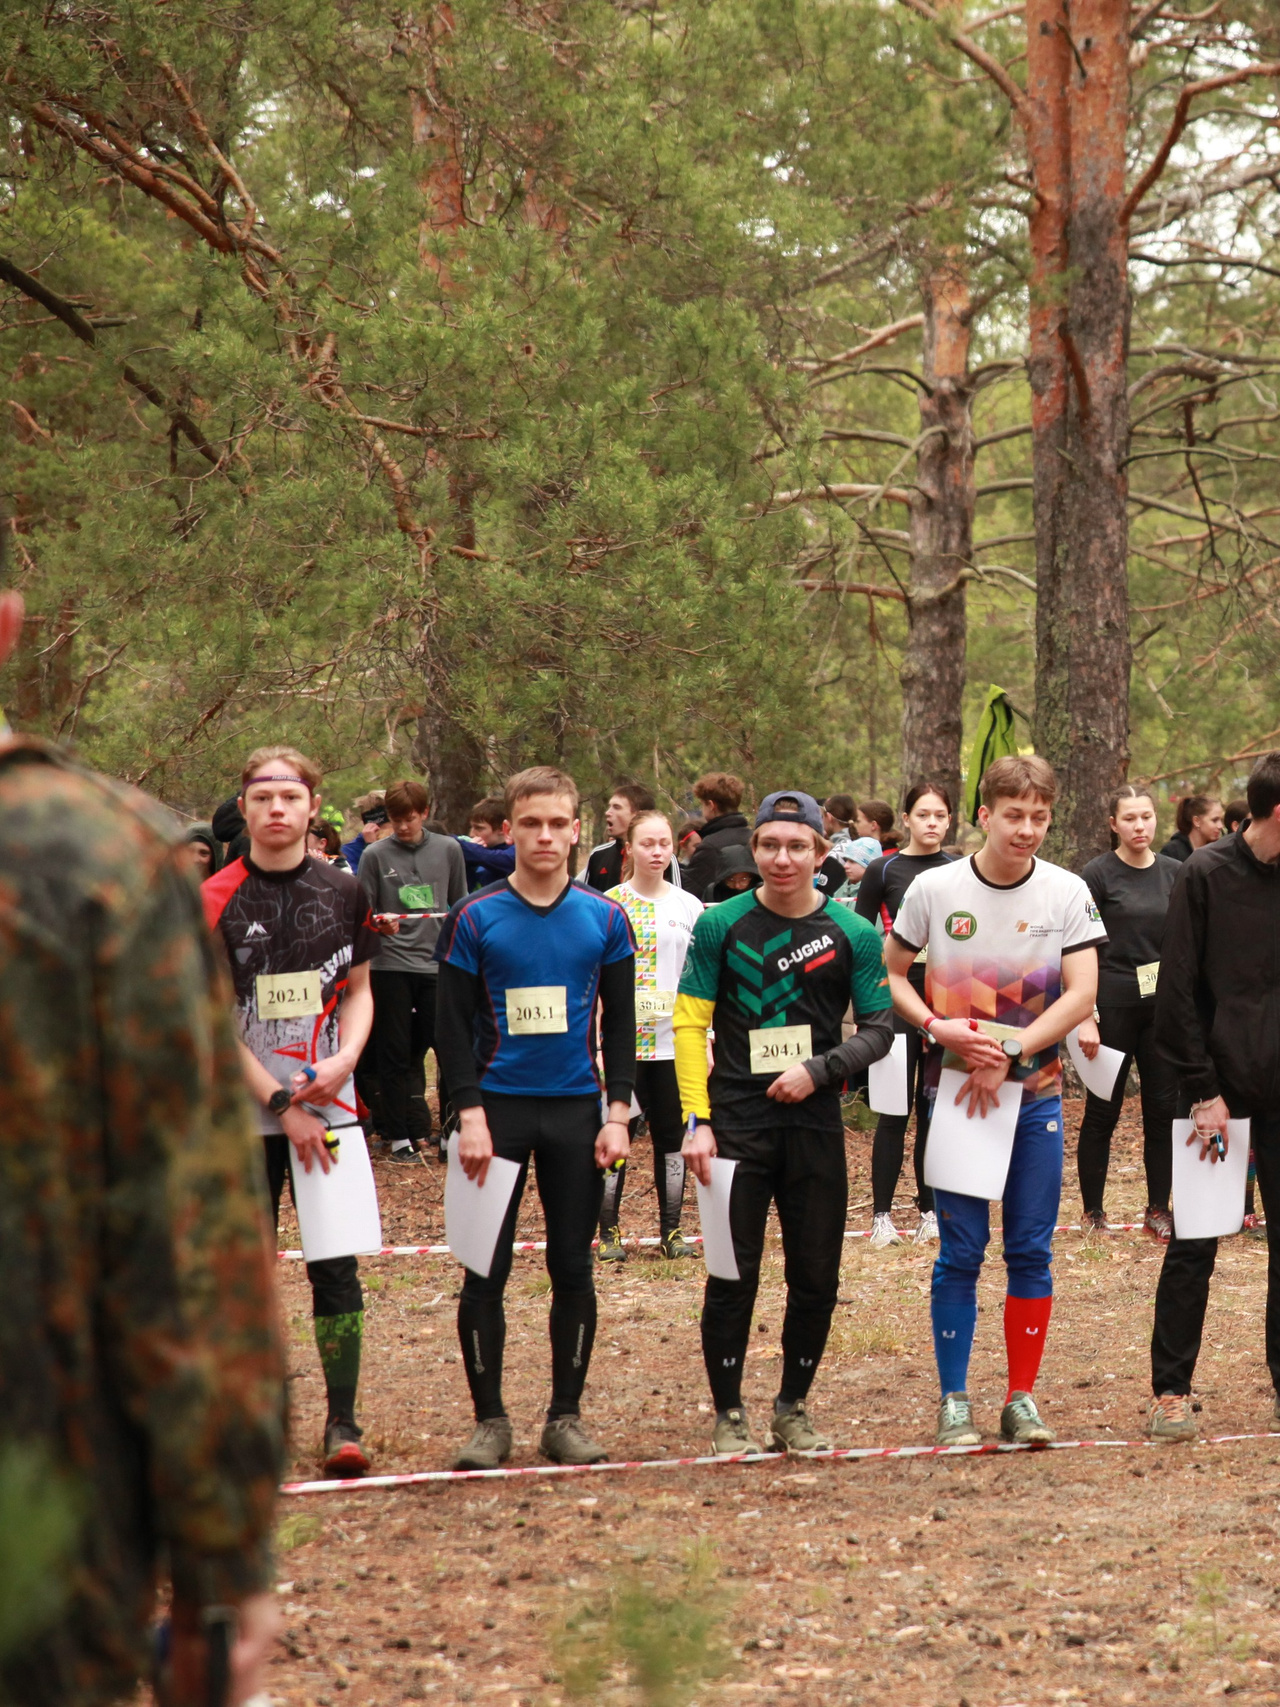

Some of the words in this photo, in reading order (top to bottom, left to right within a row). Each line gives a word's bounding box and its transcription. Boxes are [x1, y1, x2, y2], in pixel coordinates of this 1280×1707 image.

[777, 934, 834, 972] O-UGRA
[267, 987, 309, 1004] 202.1
[516, 1006, 553, 1021] 203.1
[761, 1042, 802, 1058] 204.1
